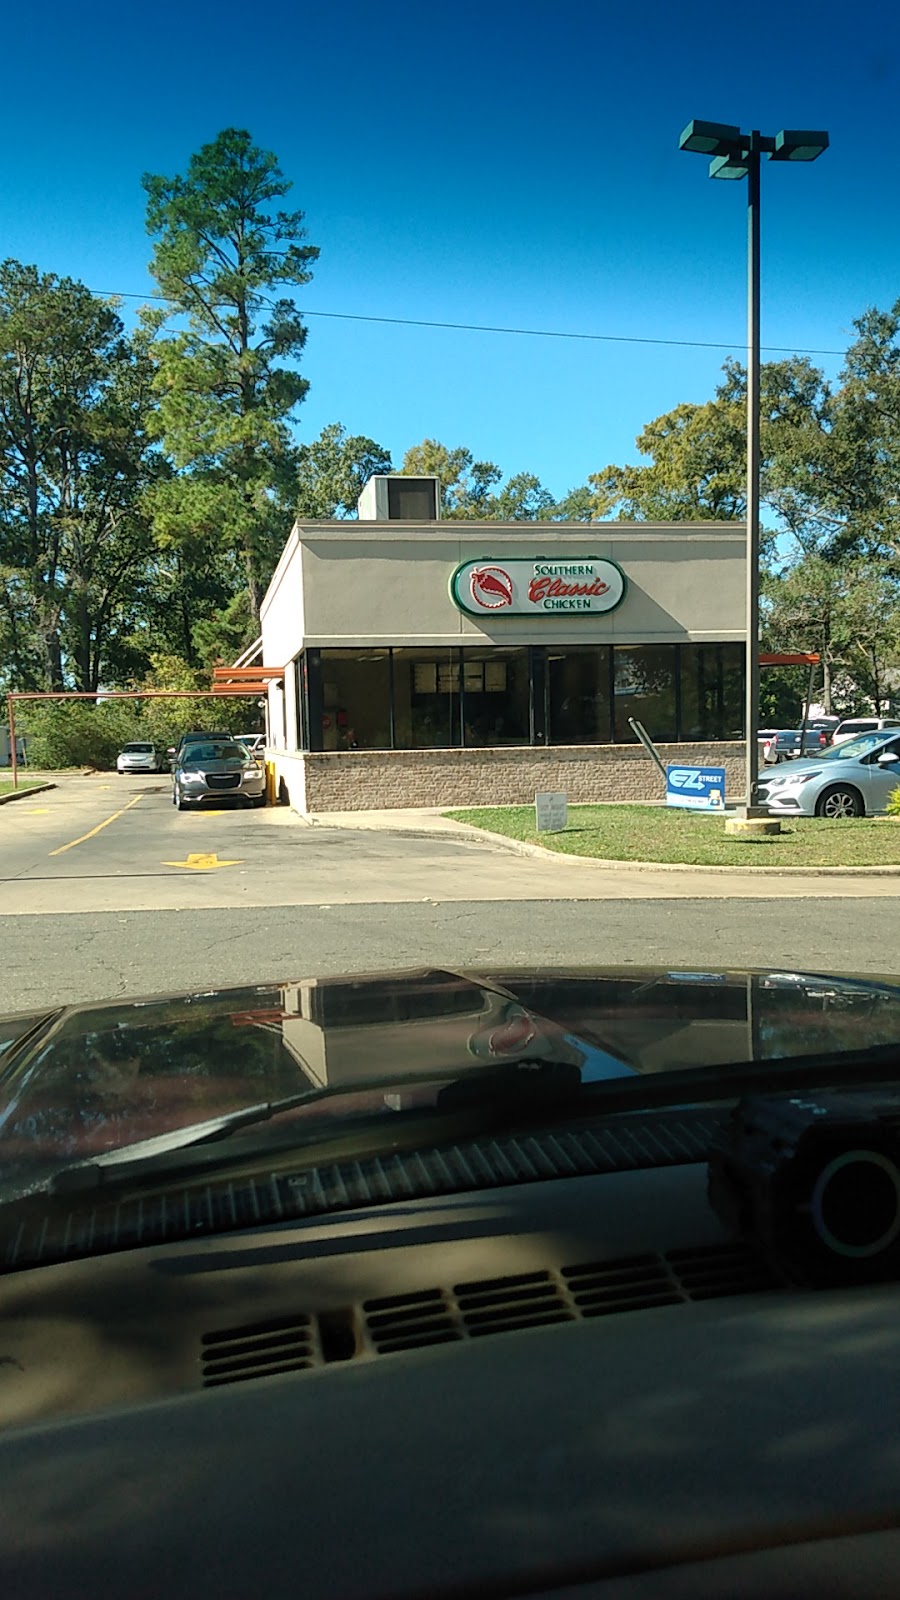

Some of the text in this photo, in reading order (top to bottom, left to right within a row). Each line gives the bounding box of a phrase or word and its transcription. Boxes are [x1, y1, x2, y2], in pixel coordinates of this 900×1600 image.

[535, 565, 593, 575] SOUTHERN
[528, 577, 611, 603] Classic
[543, 599, 591, 609] CHICKEN
[669, 769, 722, 790] EZ STREET
